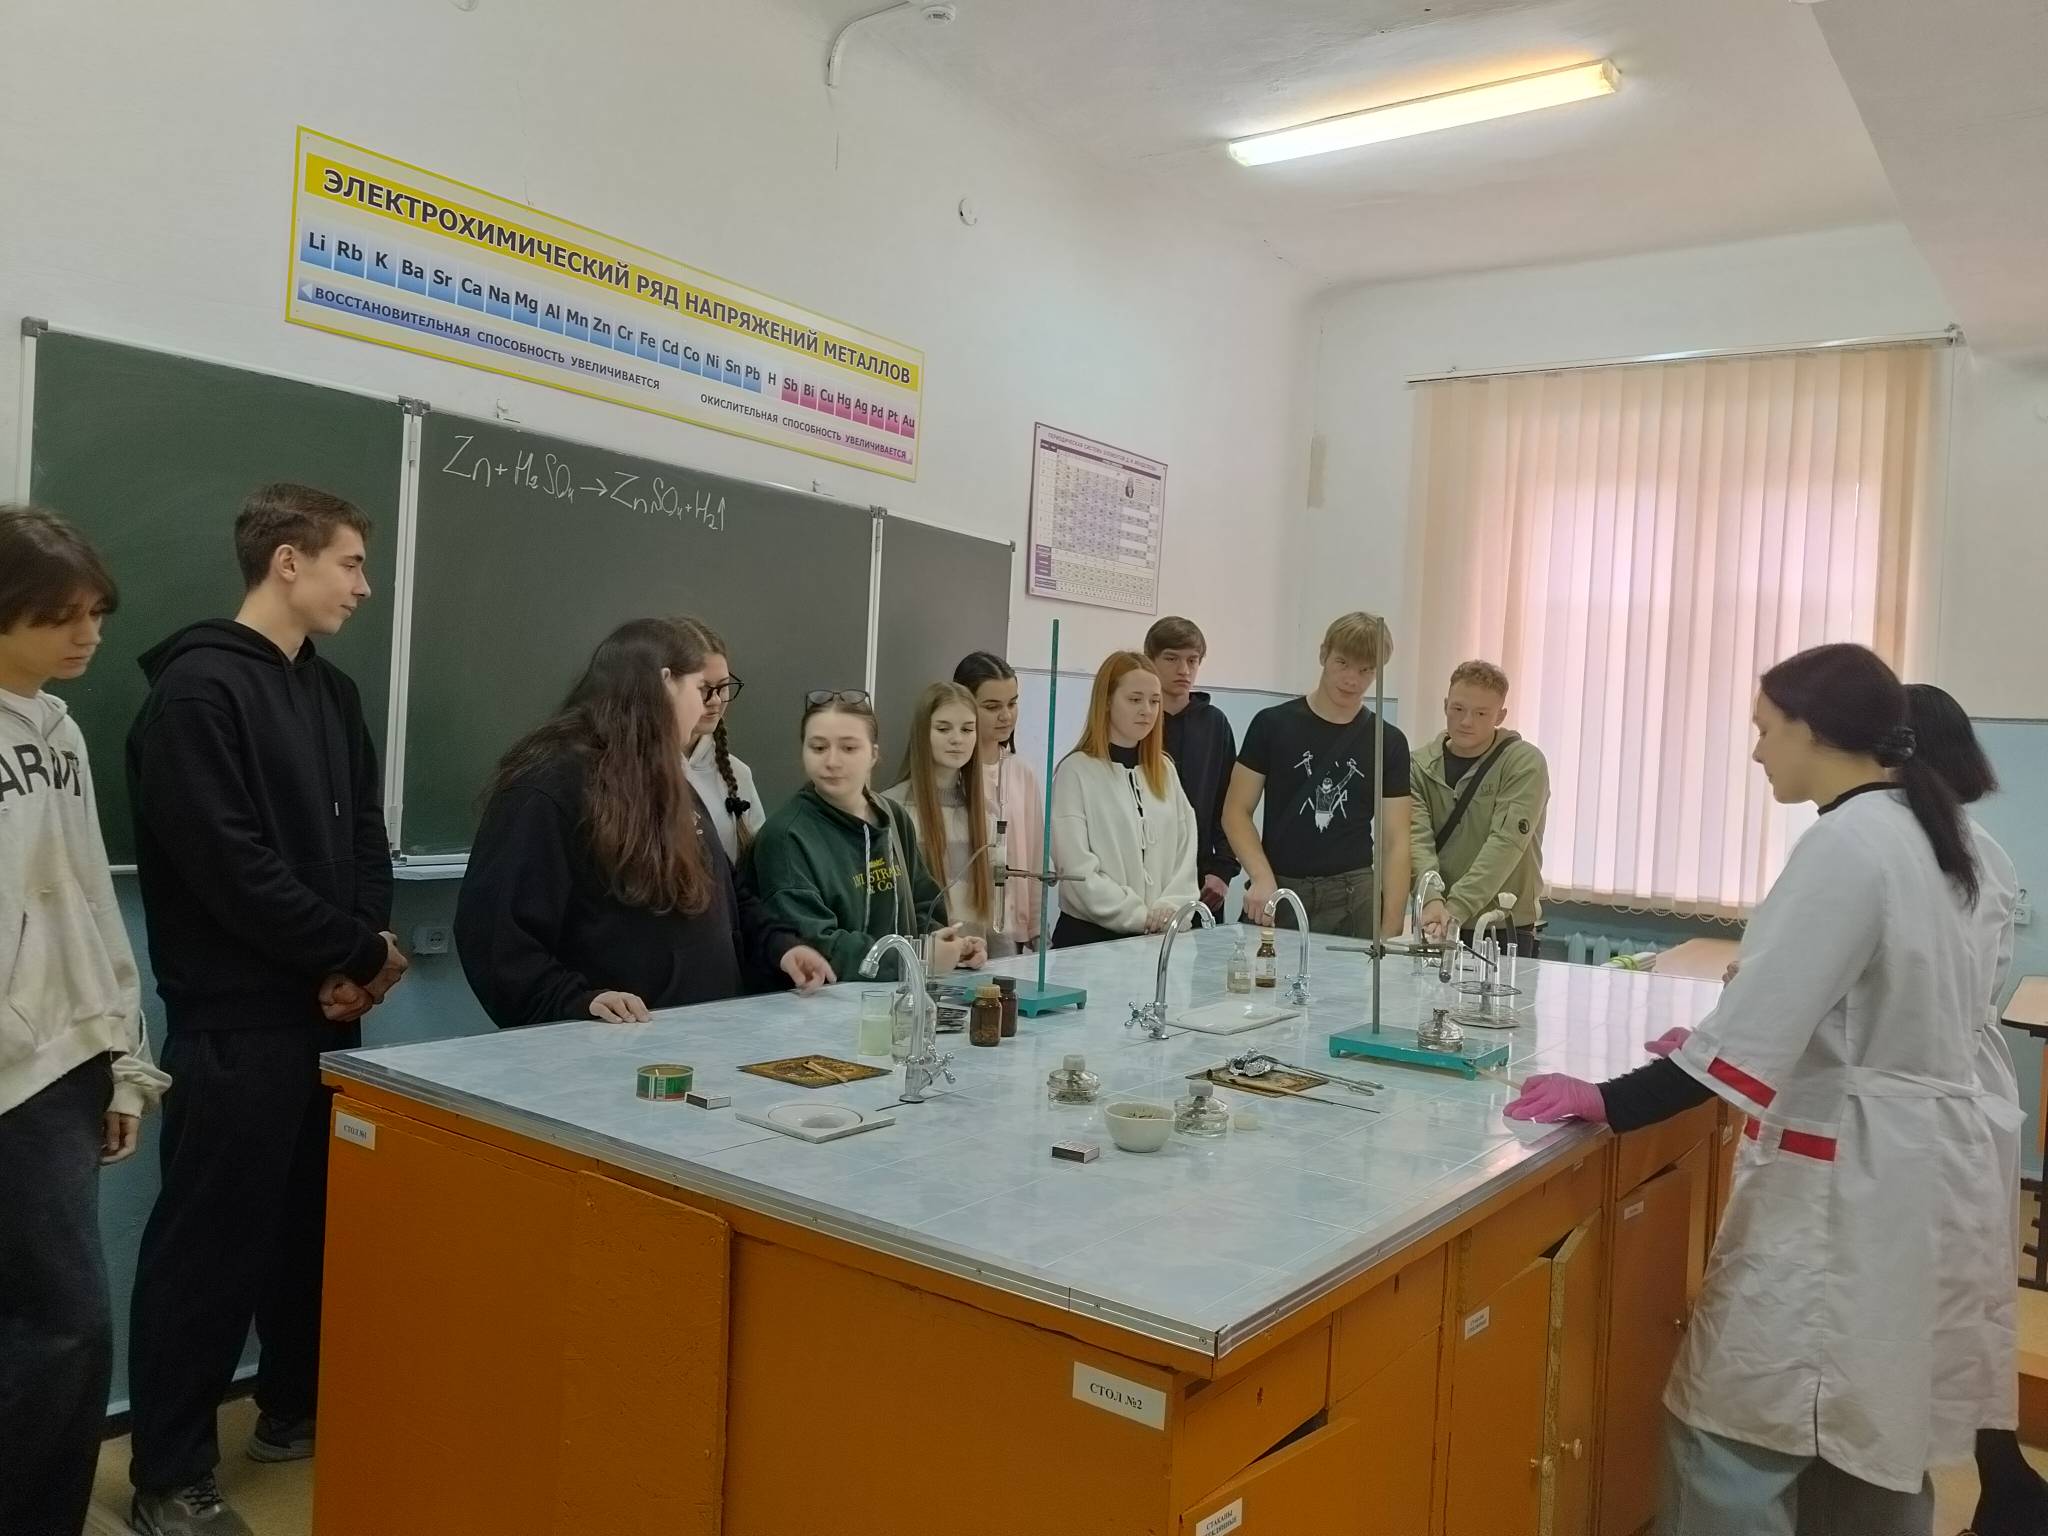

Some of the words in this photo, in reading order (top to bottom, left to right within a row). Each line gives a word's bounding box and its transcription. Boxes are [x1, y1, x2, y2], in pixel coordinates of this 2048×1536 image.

[323, 169, 629, 288] ЭЛЕКТРОХИМИЧЕСКИЙ
[636, 275, 680, 309] РЯД
[685, 291, 819, 353] НАПРЯЖЕНИЙ
[823, 340, 911, 384] МЕТАЛЛОВ
[309, 232, 325, 252] Li
[337, 240, 363, 262] Rb
[375, 251, 388, 270] K
[401, 260, 424, 280] Ba
[433, 269, 452, 287] Sr
[461, 278, 482, 297] Ca
[488, 285, 510, 305] Na
[515, 291, 538, 314] Mg
[545, 303, 561, 320] Al
[567, 309, 588, 329] Mn
[593, 316, 611, 336] Zn
[617, 325, 633, 341] Cr
[640, 332, 656, 348] Fe
[662, 339, 679, 356] Cd
[683, 346, 700, 363] Co
[706, 353, 719, 369] Ni
[725, 359, 741, 376] Sn
[745, 364, 761, 381] Pb
[768, 372, 777, 386] H
[783, 377, 798, 394] Sb
[804, 383, 815, 398] Bi
[820, 389, 834, 404] Cu
[837, 392, 851, 410] Hg
[855, 398, 868, 415] Ag
[871, 404, 884, 419] Pd
[888, 410, 899, 424] Pt
[902, 414, 915, 428] Au
[315, 287, 471, 338] ВОССТАНОВИТЕЛЬНАЯ
[477, 331, 565, 363] СПОСОБНОСТЬ
[571, 356, 660, 390] УВЕЛИЧИВАЕТСЯ
[700, 393, 778, 424] ОКИСЛИТЕЛЬНАЯ
[782, 417, 842, 441] СПОСОБНОСТЬ
[845, 434, 907, 460] УВЕЛИЧИВАЕТСЯ
[1089, 1382, 1122, 1403] СТОЛ
[1124, 1396, 1143, 1410] №2
